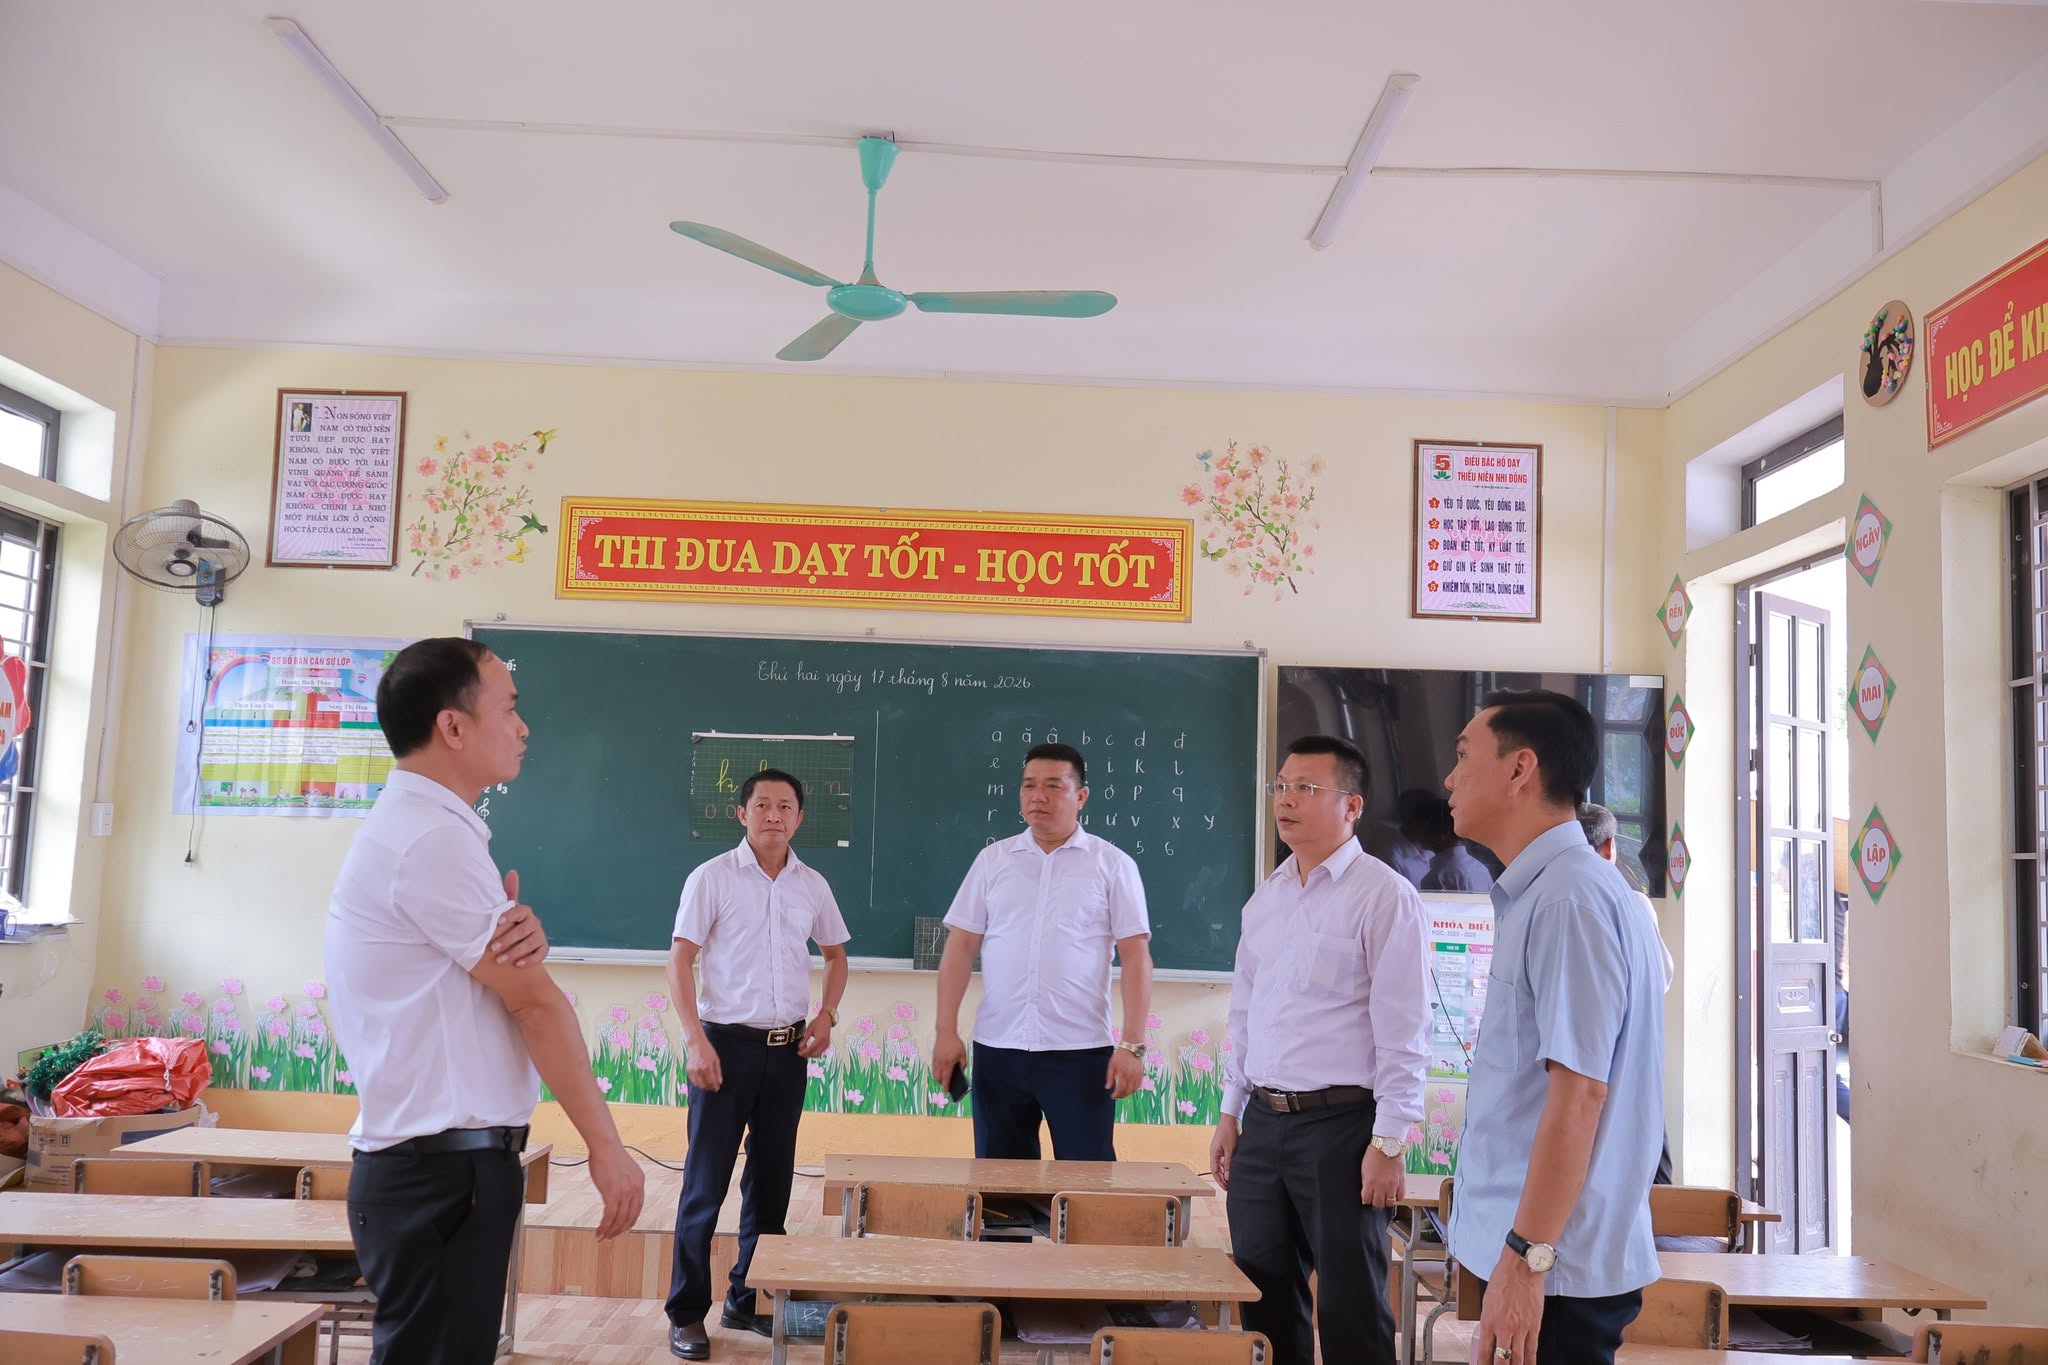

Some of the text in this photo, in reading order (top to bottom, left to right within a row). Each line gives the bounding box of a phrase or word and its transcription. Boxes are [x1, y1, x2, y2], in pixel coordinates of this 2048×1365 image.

[1946, 339, 1983, 402] HỌC
[1989, 301, 2015, 377] ĐỂ
[373, 412, 391, 420] VIỆT
[356, 424, 372, 432] TRỞ
[342, 436, 365, 444] ĐƯỢC
[350, 447, 365, 455] TỘC
[313, 457, 323, 465] CÓ
[374, 458, 388, 466] ĐÀI
[1435, 455, 1450, 470] 5
[1465, 455, 1520, 470] ĐIỀU BÁC HỒ DẠY
[1458, 469, 1527, 483] THIẾU NIÊN NHI ĐỒNG
[365, 480, 388, 489] QUỐC
[1444, 496, 1453, 508] YÊU
[1485, 500, 1494, 510] YÊU
[285, 513, 302, 521] MỘT
[284, 525, 300, 533] HỌC
[318, 525, 333, 533] CỦA
[1443, 519, 1453, 532] HỌC
[1457, 518, 1467, 532] TẬP
[1485, 521, 1495, 531] LAO
[1461, 538, 1471, 551] KẾT
[1500, 539, 1511, 555] LUẬT
[1856, 526, 1880, 552] NGÀY
[595, 532, 1155, 592] THI ĐUA DẠY TỐT - HỌC TỐT
[1481, 562, 1493, 573] SINH
[1498, 561, 1511, 576] THẬT
[1443, 579, 1459, 593] KHIÊM
[1472, 581, 1485, 595] THẬT
[1669, 602, 1683, 619] RÈN
[337, 656, 350, 665] LỚP
[758, 661, 1031, 695] Thứ hai ngày 17 tháng 8 năm 2026
[1862, 684, 1881, 703] MAI
[992, 728, 1187, 749] a ă â b c d đ
[1669, 723, 1684, 740] ĐỨC
[989, 758, 1000, 768] e
[1108, 757, 1113, 773] i
[988, 784, 1004, 795] m
[1104, 784, 1114, 799] ơ
[1173, 787, 1183, 802] q
[987, 809, 997, 822] r
[1106, 813, 1118, 826] ư
[1204, 815, 1215, 829] y
[1136, 841, 1174, 855] 5 6
[1866, 843, 1886, 866] LẬP
[1433, 920, 1463, 929] KHÓA
